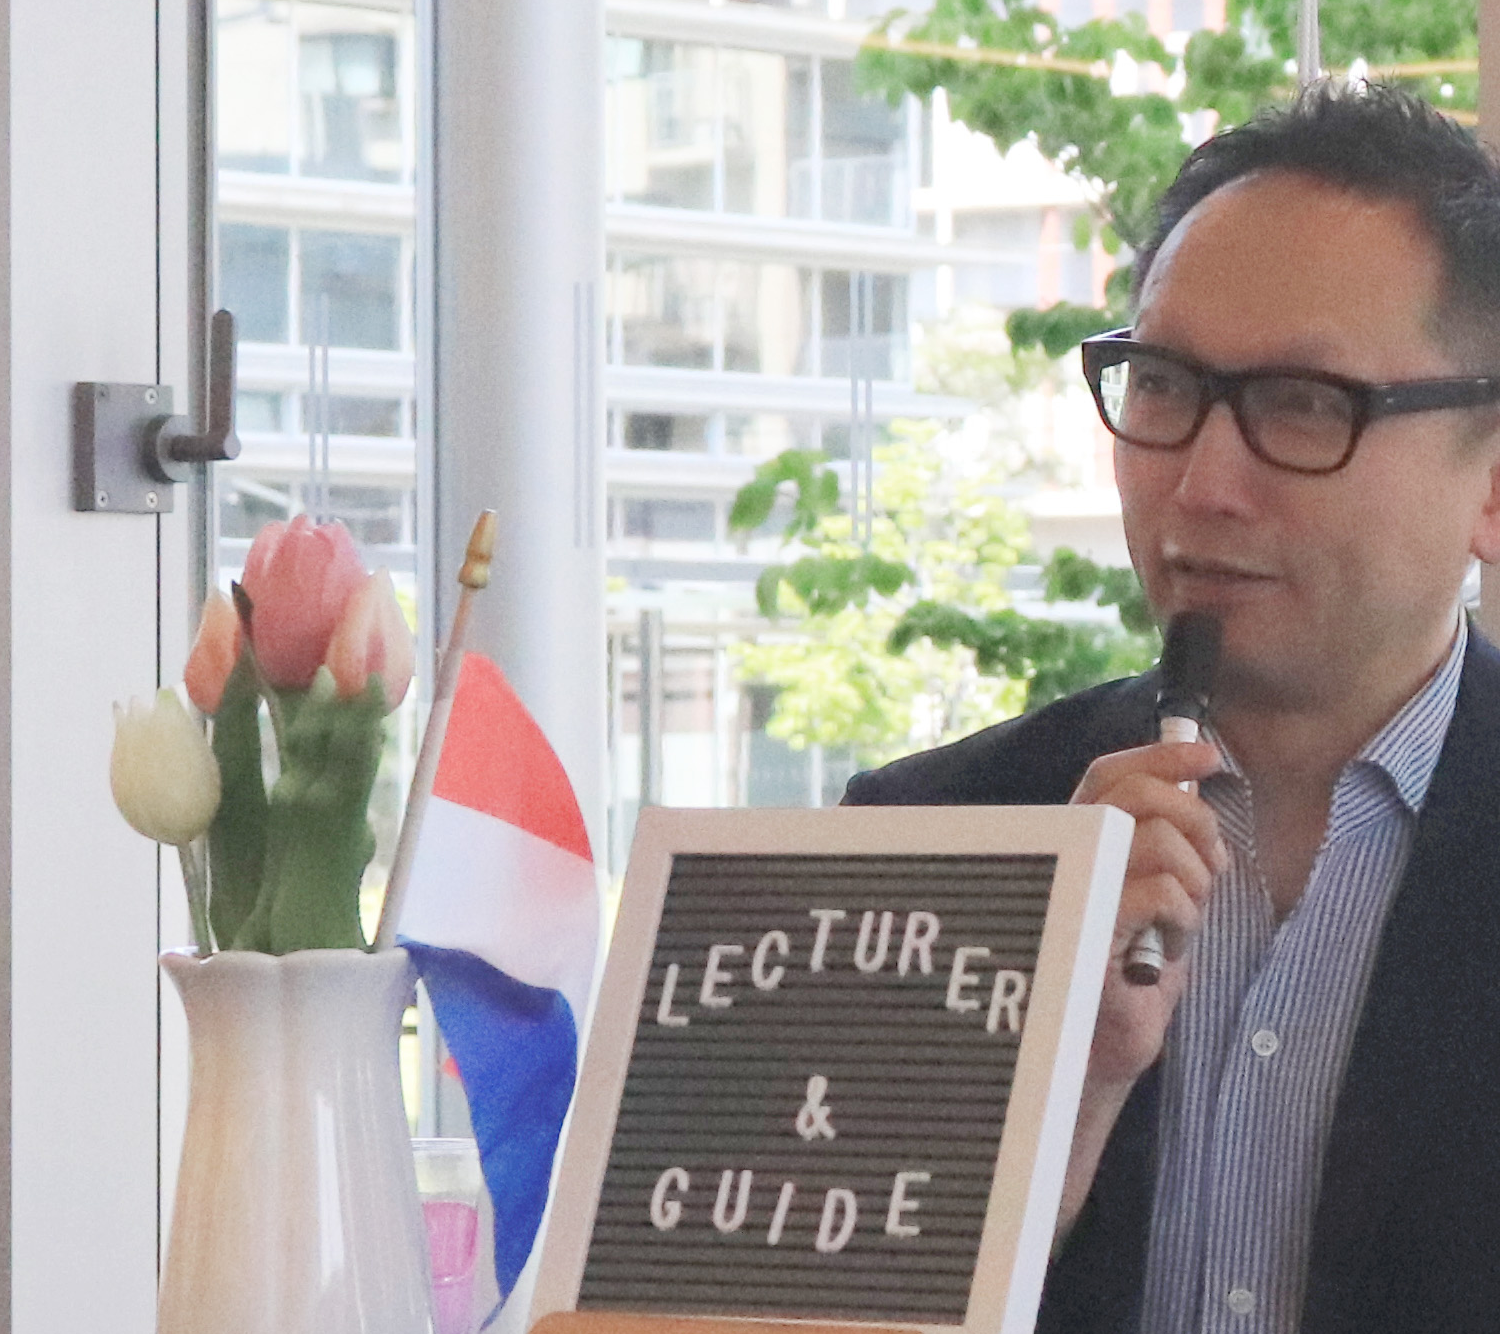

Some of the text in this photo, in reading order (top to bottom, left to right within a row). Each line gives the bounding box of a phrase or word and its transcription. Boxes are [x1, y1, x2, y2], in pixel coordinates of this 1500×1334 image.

[655, 908, 1028, 1034] LECTURER
[795, 1074, 838, 1141] &
[649, 1166, 932, 1254] GUIDE
